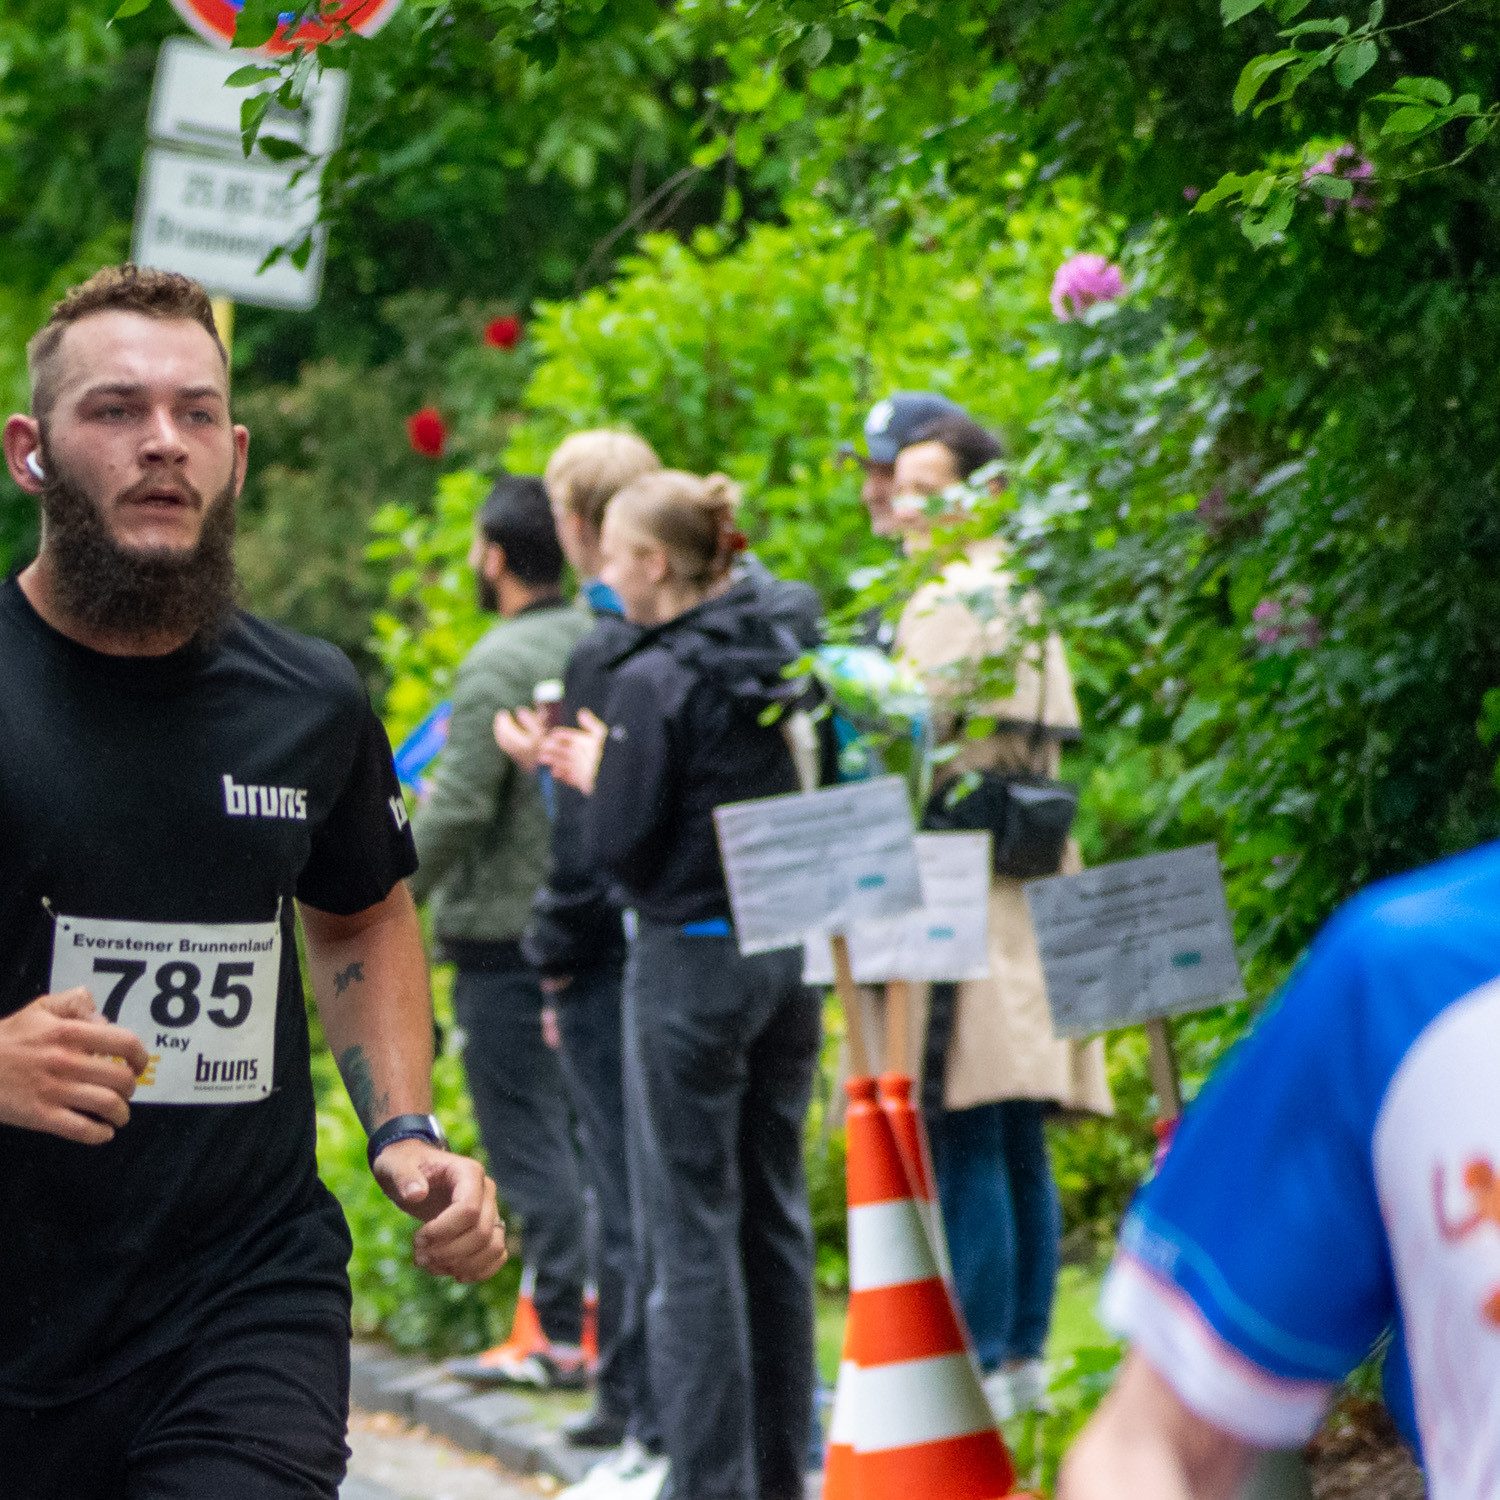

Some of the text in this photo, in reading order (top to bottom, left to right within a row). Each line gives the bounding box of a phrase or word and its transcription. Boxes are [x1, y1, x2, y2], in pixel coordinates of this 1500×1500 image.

[222, 774, 308, 820] bruns
[73, 933, 274, 953] Everstener Brunnenlauf
[93, 957, 254, 1029] 785
[156, 1034, 191, 1051] Kay
[195, 1053, 258, 1082] bruns
